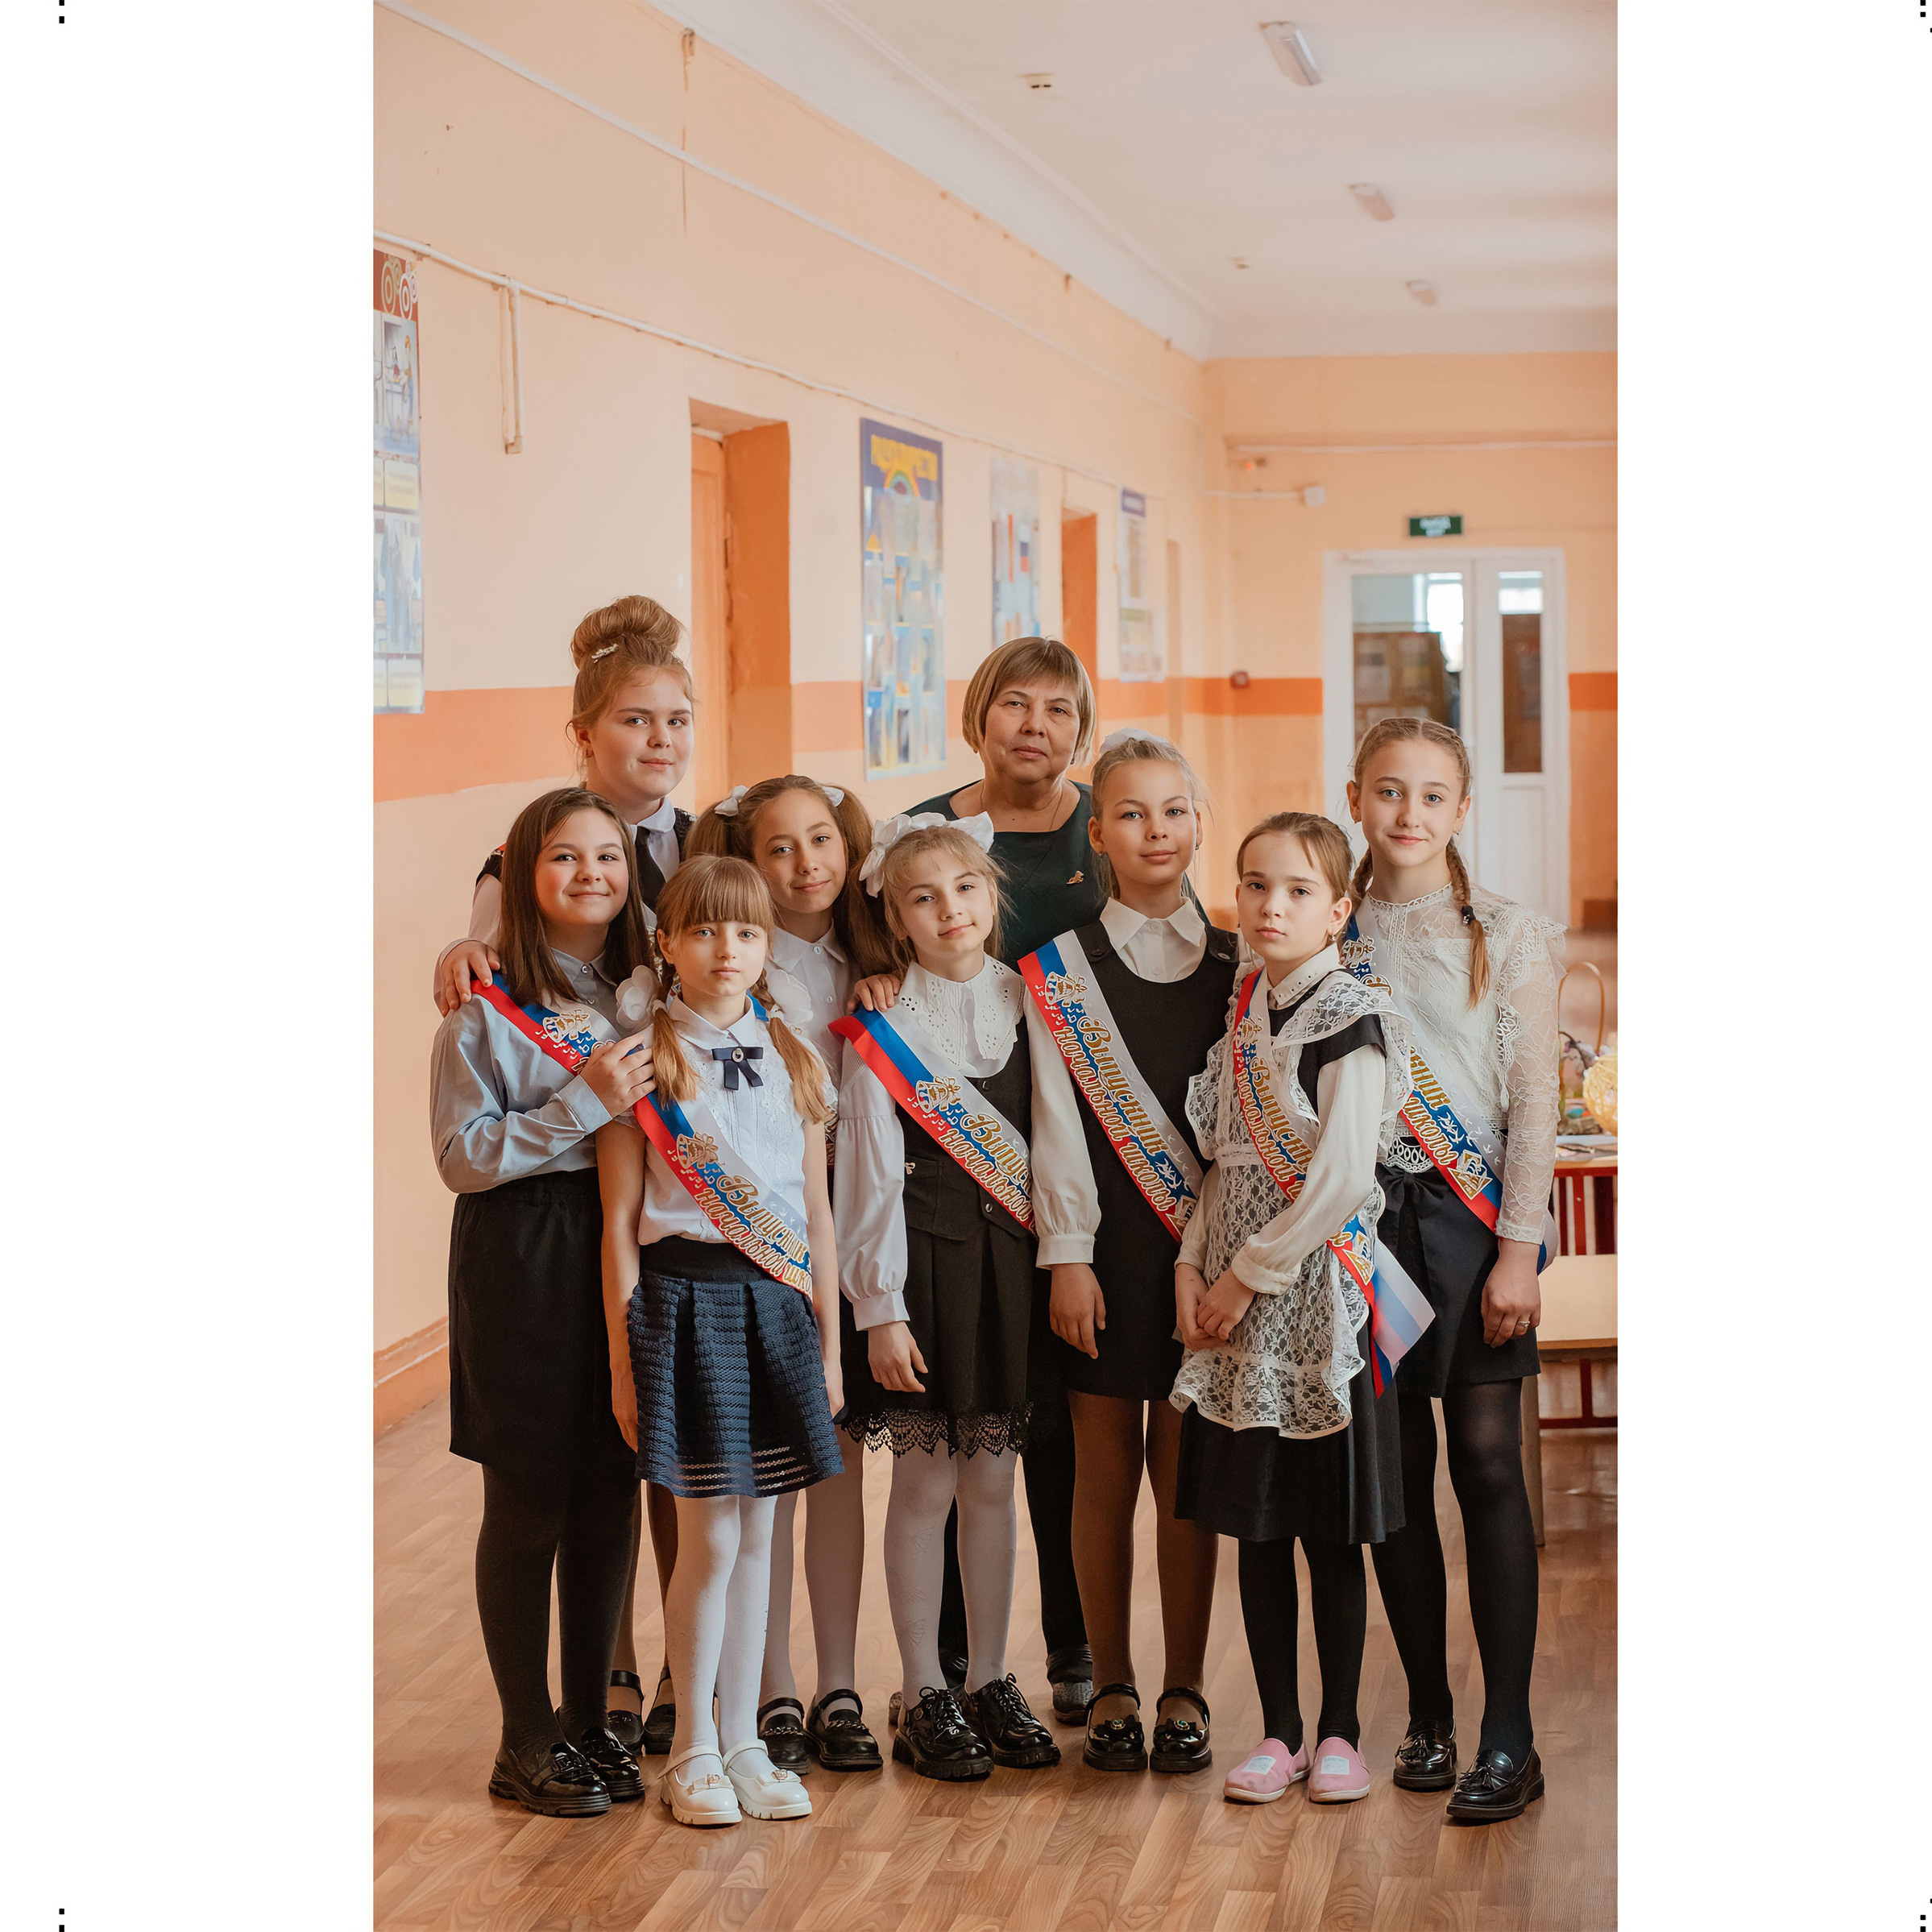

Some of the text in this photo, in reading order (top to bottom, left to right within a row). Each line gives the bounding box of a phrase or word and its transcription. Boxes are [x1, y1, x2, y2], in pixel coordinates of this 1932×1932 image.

[1077, 1016, 1169, 1156] Выпускник
[1250, 1056, 1313, 1167] Выпускн
[960, 1113, 1031, 1194] Выпус
[1119, 1142, 1176, 1211] школы
[716, 1175, 808, 1263] Выпускник
[782, 1262, 812, 1295] шко
